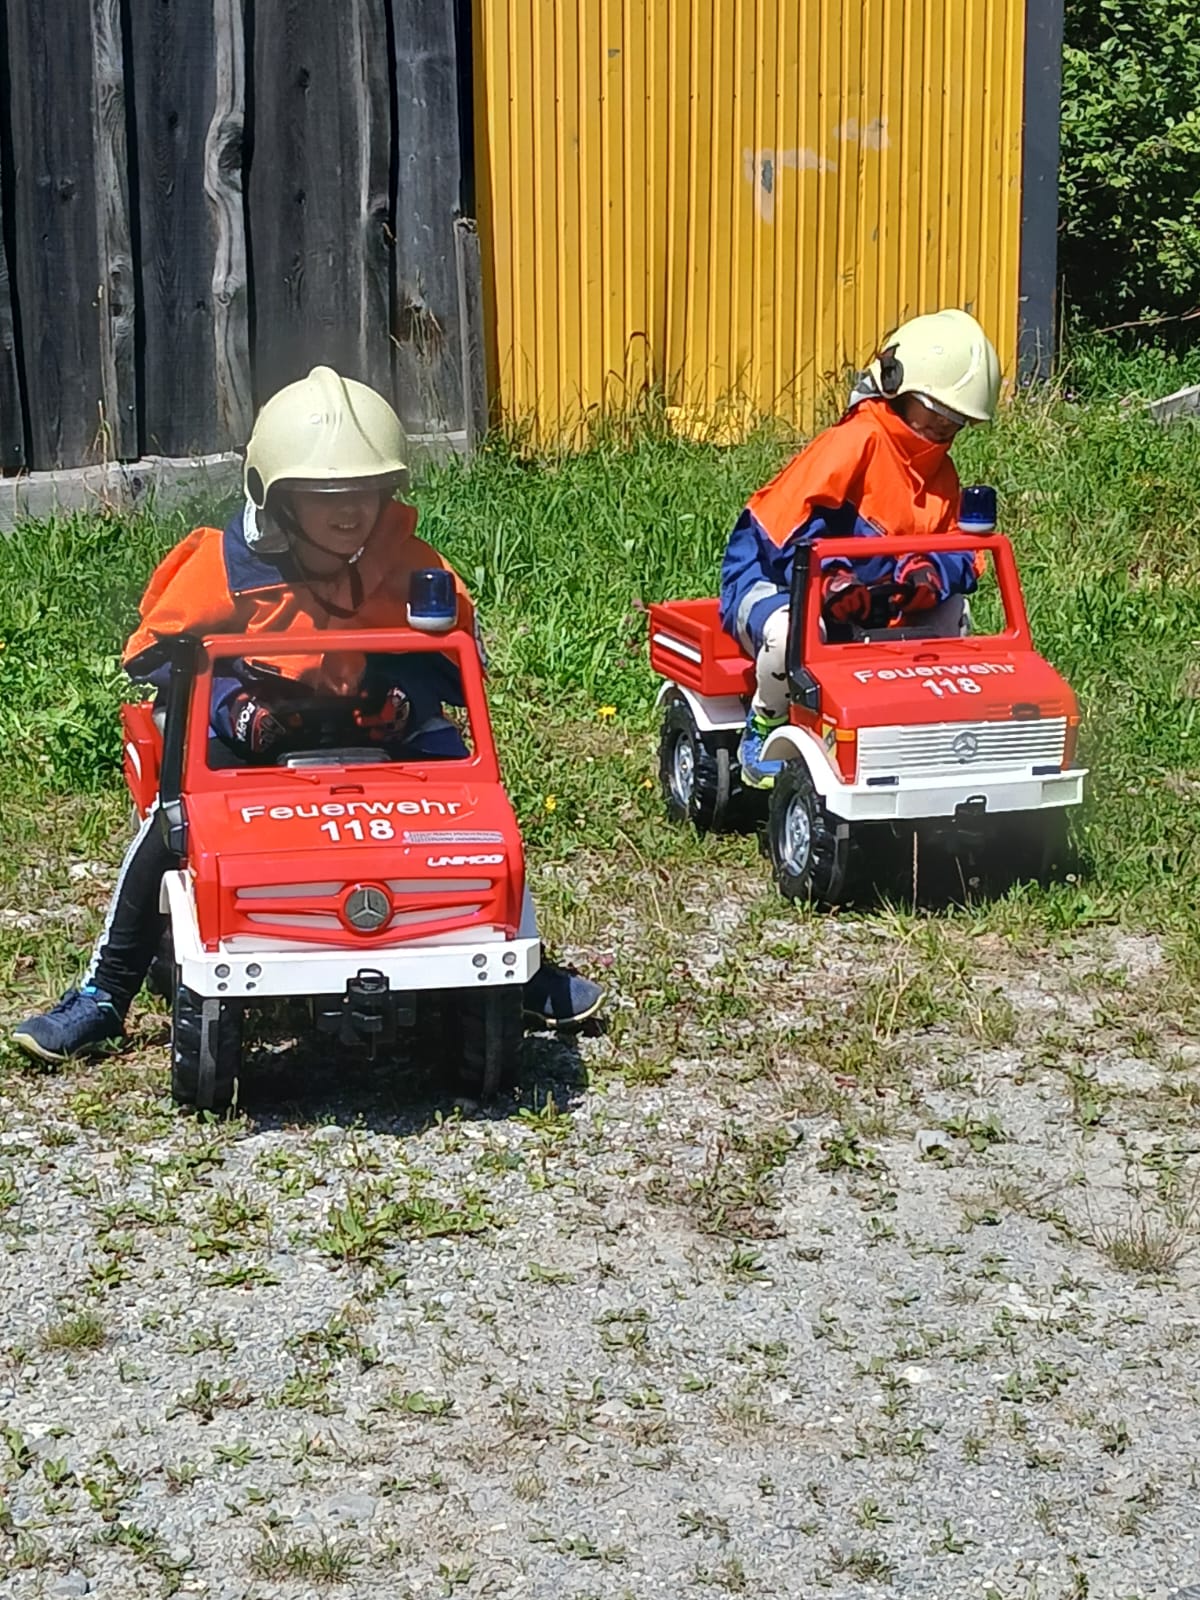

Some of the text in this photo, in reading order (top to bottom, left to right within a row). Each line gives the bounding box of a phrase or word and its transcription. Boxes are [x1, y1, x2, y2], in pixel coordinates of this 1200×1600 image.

[853, 662, 1016, 684] Feuerwehr
[922, 677, 982, 696] 118
[240, 798, 462, 823] Feuerwehr
[320, 819, 394, 841] 118
[427, 855, 504, 868] UNIMOG
